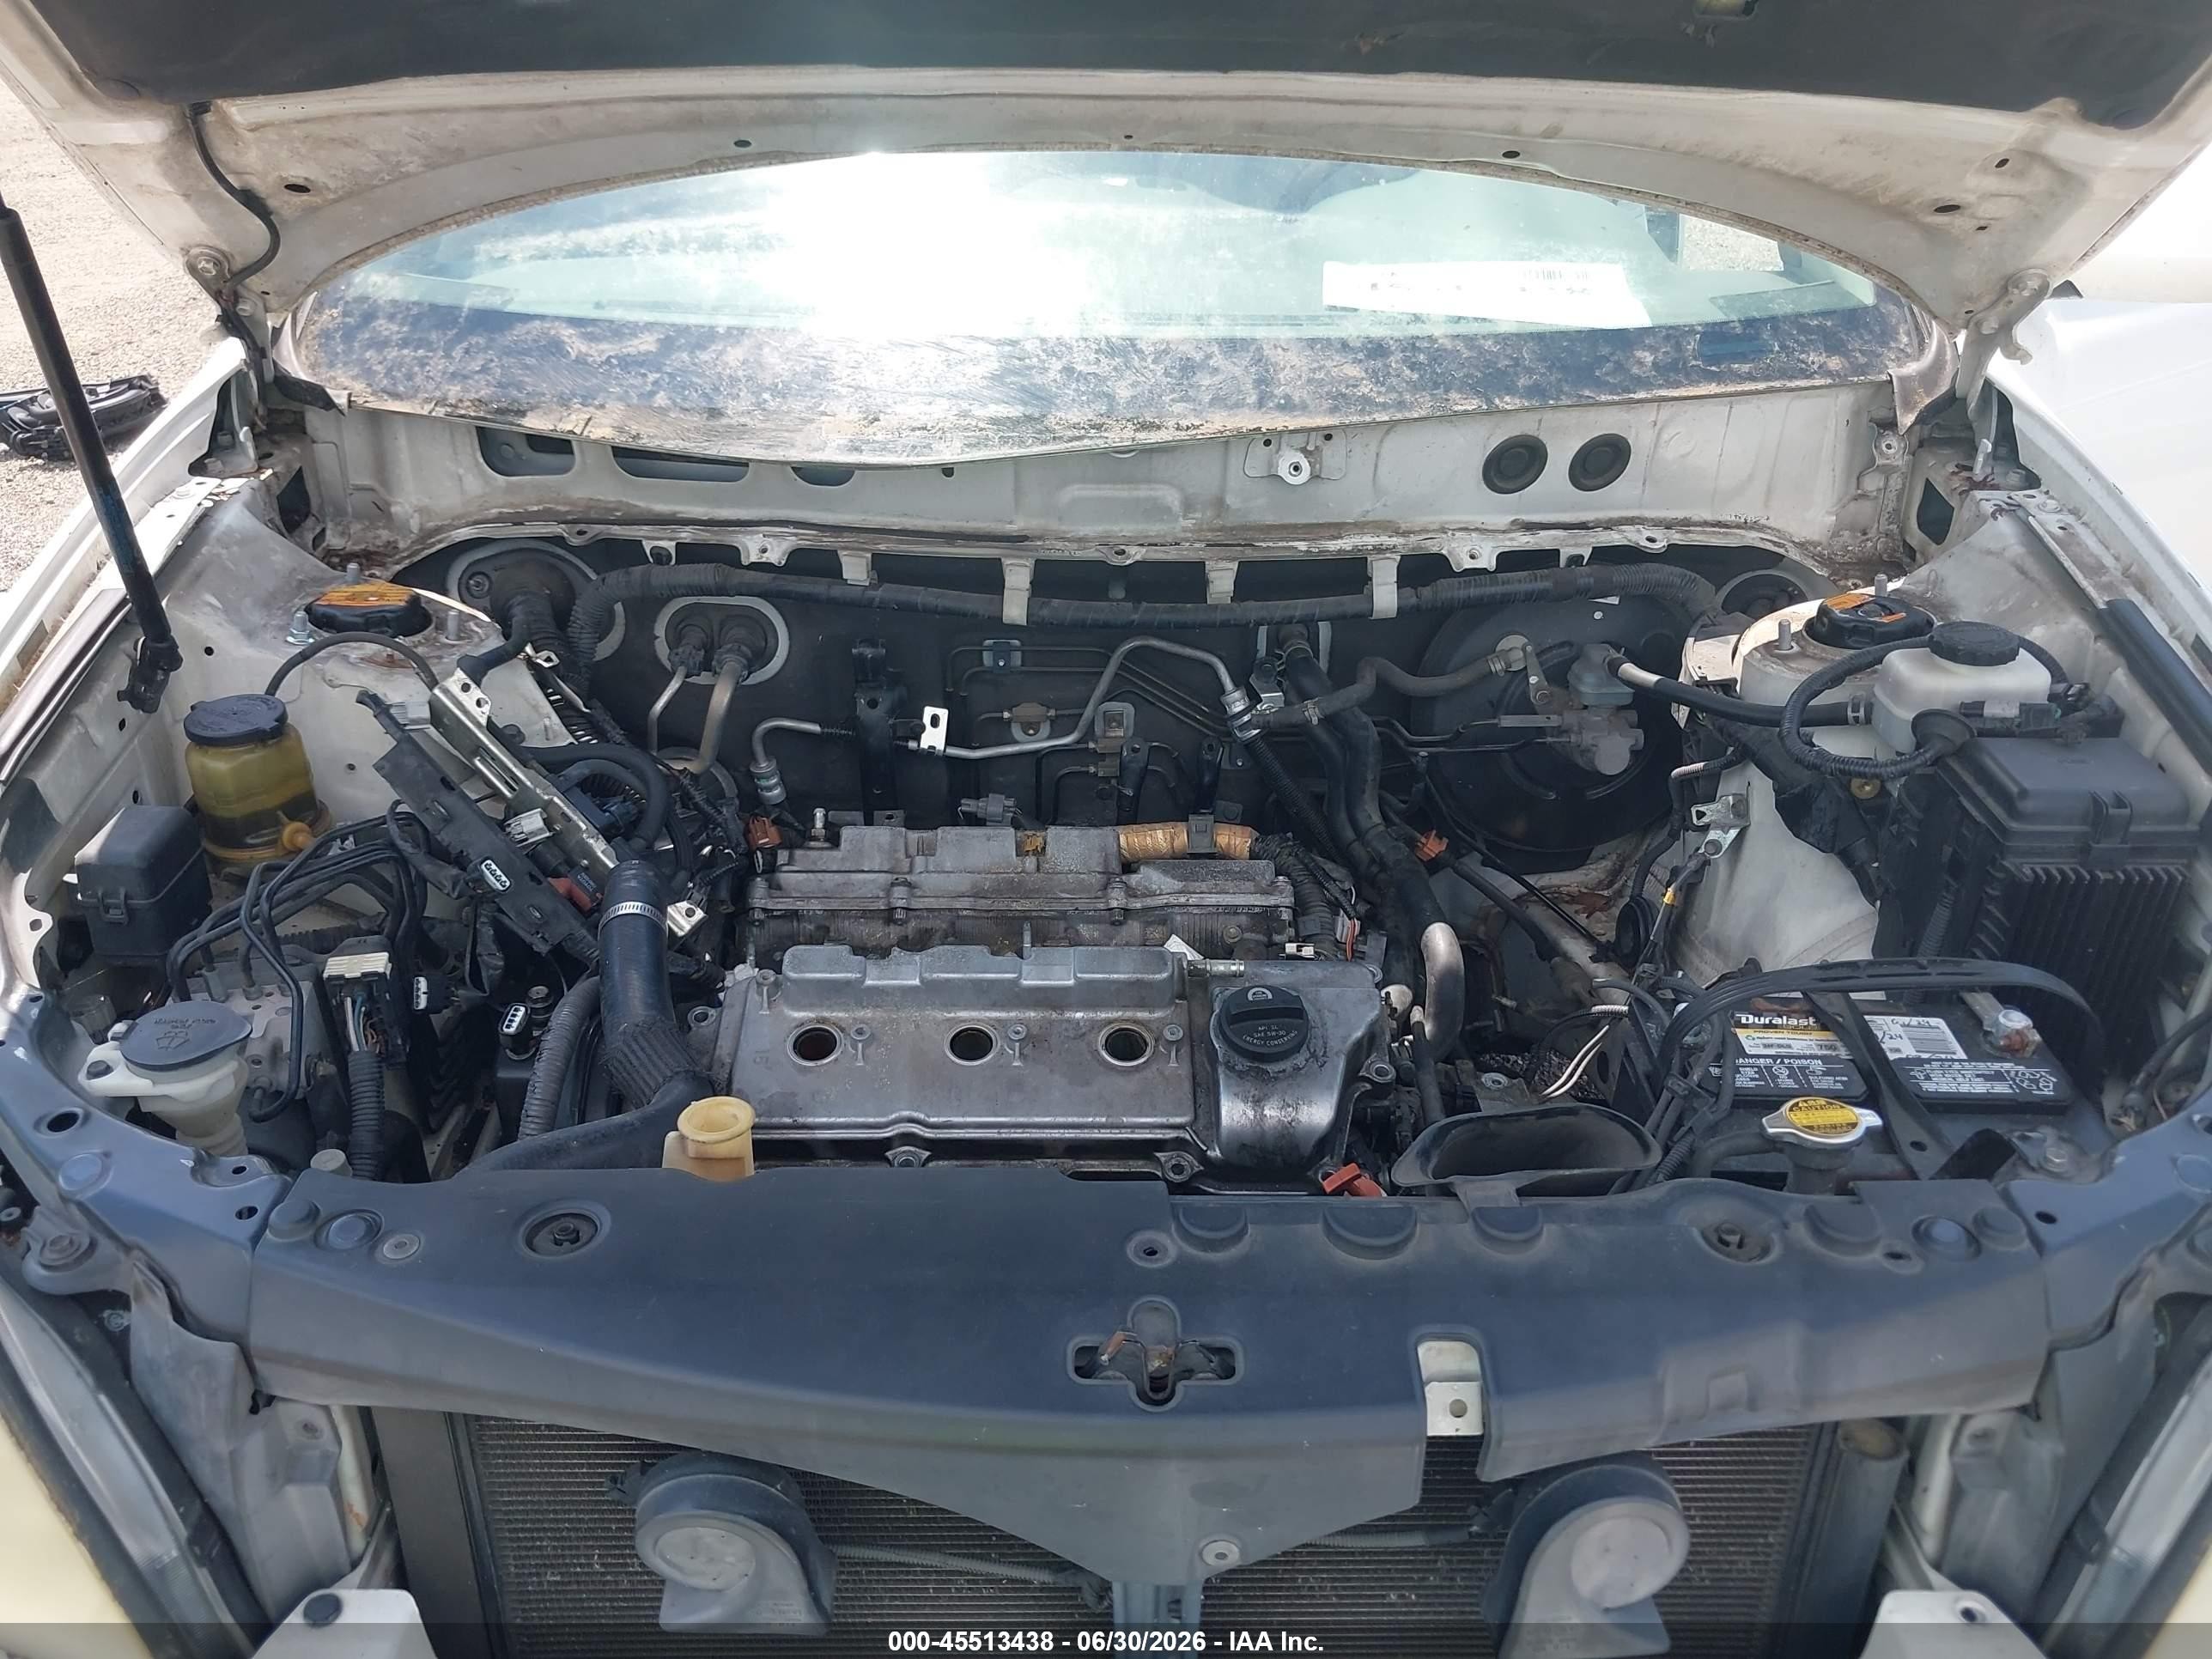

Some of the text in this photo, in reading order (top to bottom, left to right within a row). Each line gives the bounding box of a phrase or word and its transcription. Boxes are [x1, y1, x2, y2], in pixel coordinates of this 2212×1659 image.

[1735, 1014, 1818, 1026] Duralast
[1243, 1030, 1297, 1046] ENERGY CONSERVING
